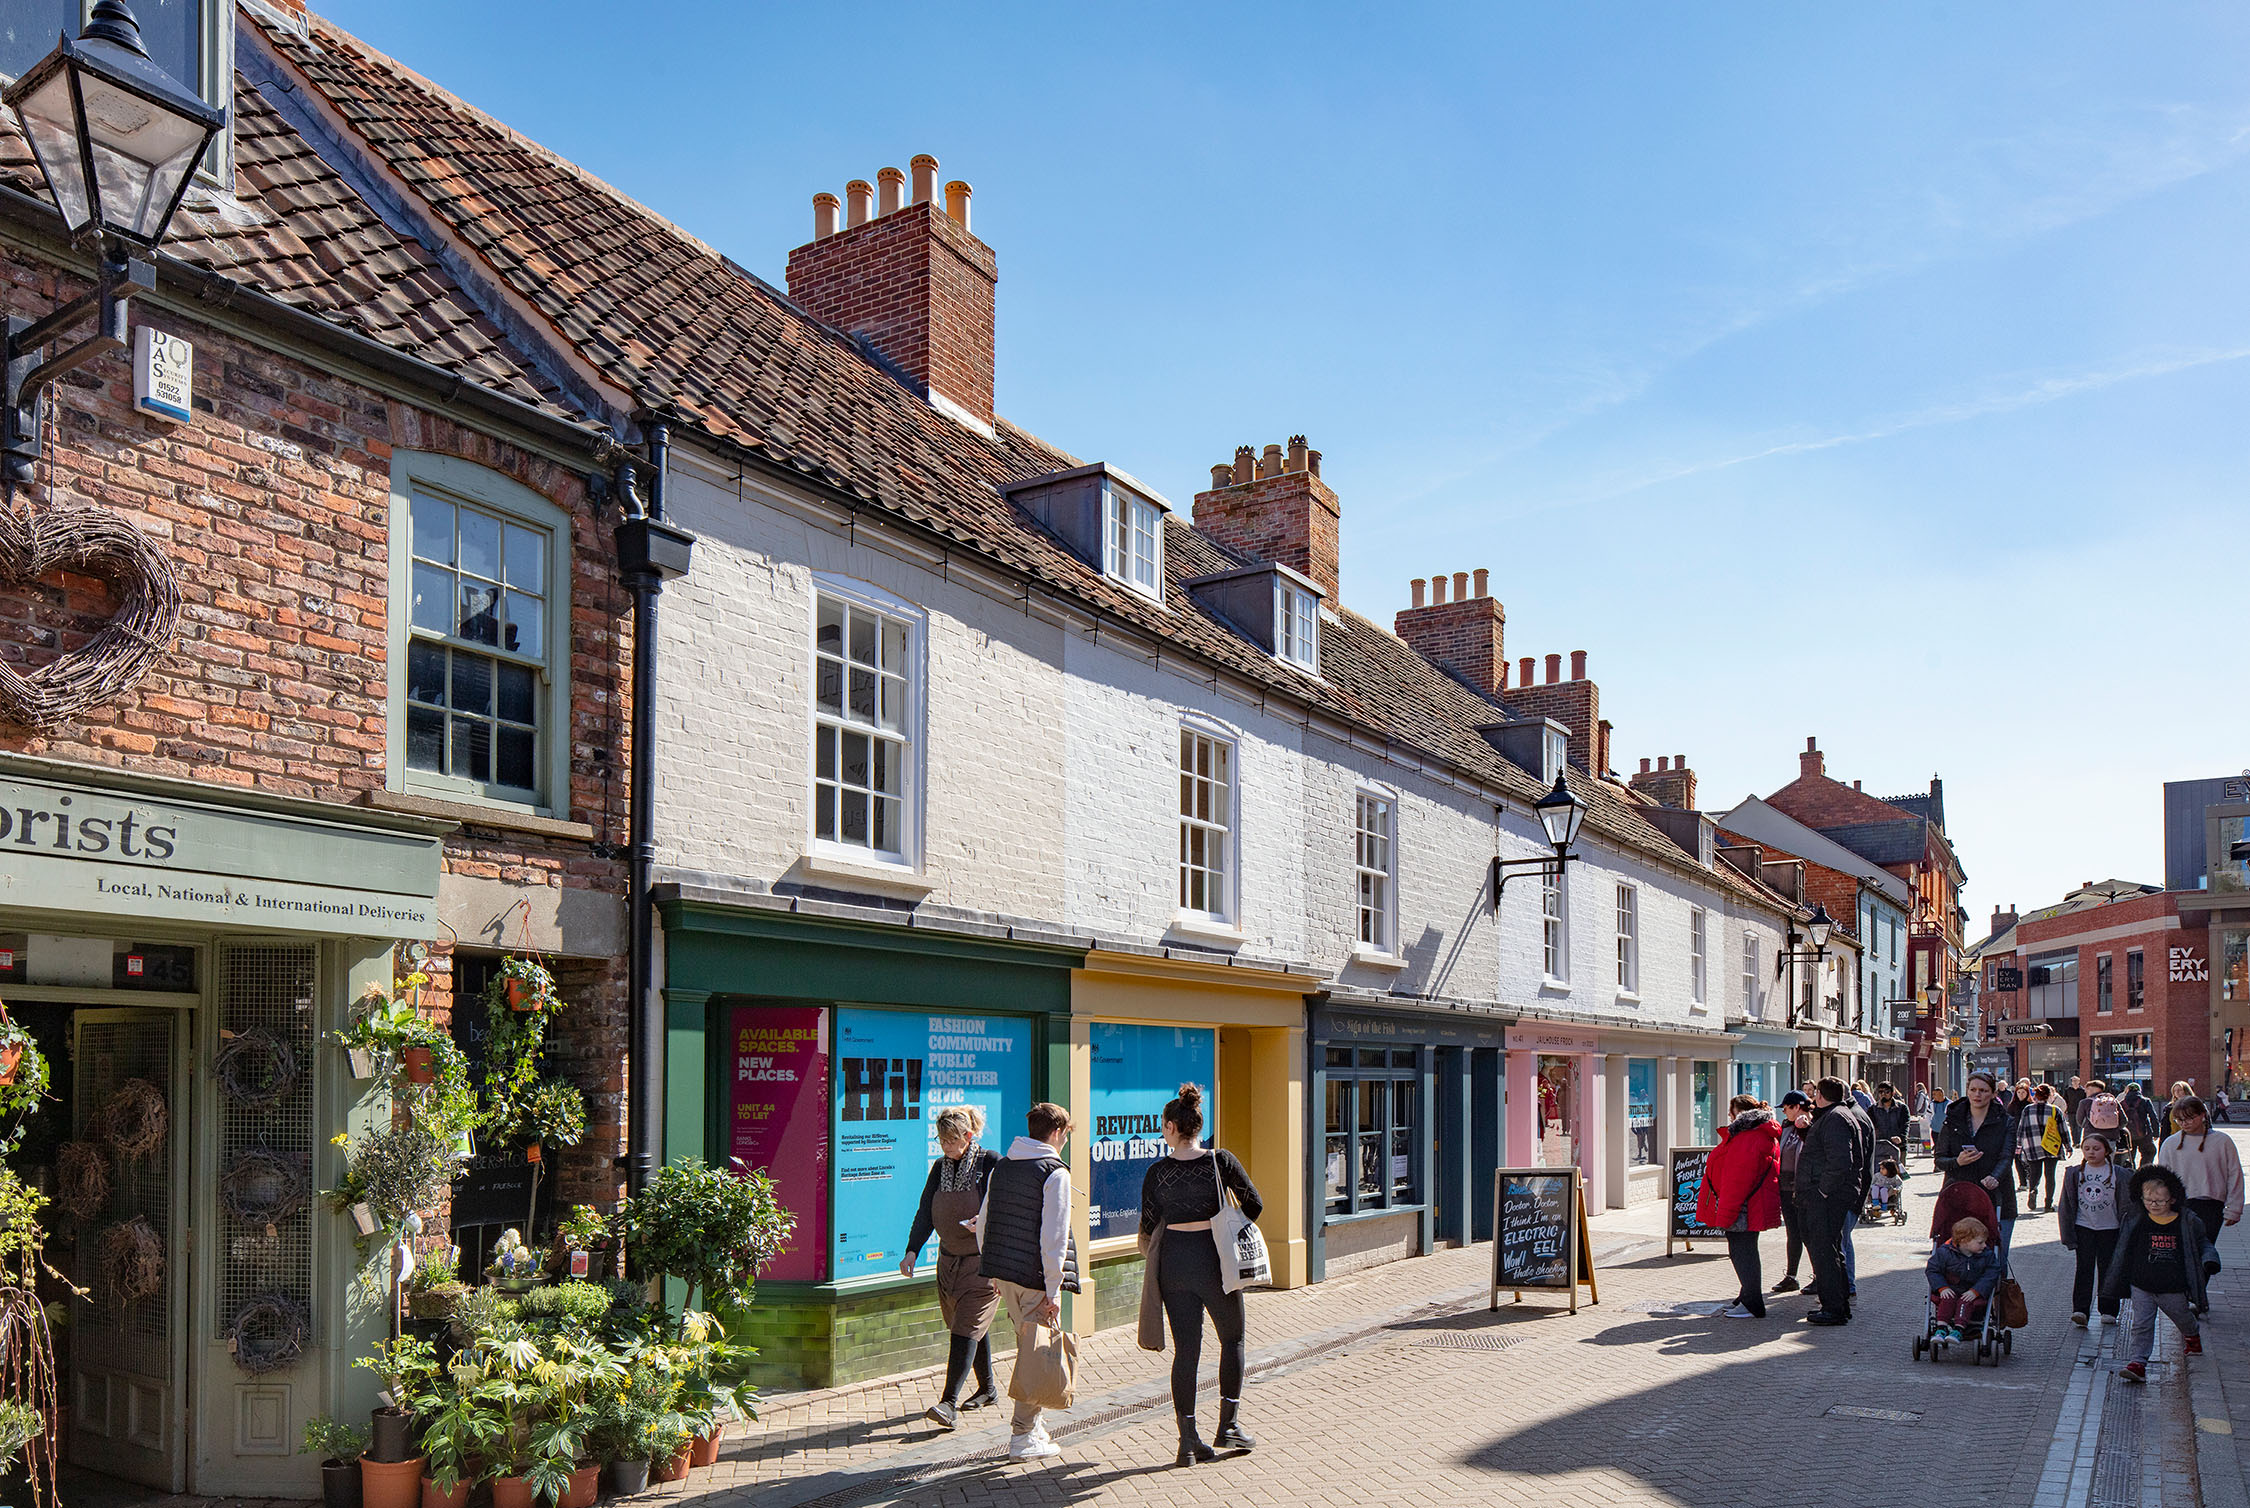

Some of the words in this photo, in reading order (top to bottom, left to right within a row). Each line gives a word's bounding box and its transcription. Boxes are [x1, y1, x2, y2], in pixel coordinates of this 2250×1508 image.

[158, 381, 180, 395] 01522
[156, 389, 181, 404] 531058
[97, 878, 152, 898] Local,
[157, 885, 229, 904] National
[235, 892, 249, 906] &
[255, 895, 354, 916] International
[358, 904, 425, 922] Deliveries
[2170, 947, 2193, 958] EV
[2170, 959, 2206, 970] ERY
[2170, 970, 2209, 982] MAN
[928, 1017, 985, 1034] FASHION
[2006, 1024, 2038, 1035] EVERYMAN
[739, 1029, 818, 1041] AVAILABLE
[739, 1041, 799, 1053] SPACES.
[928, 1035, 1013, 1052] COMMUNITY
[739, 1057, 773, 1069] NEW
[928, 1053, 976, 1068] PUBLIC
[738, 1070, 799, 1082] PLACES.
[928, 1070, 998, 1086] TOGETHER
[841, 1057, 922, 1122] Hi!
[928, 1088, 964, 1103] CIVIC
[737, 1104, 761, 1112] UNIT
[763, 1104, 775, 1112] 44
[737, 1112, 750, 1120] TO
[752, 1112, 769, 1120] LET
[1096, 1114, 1163, 1136] REVITAL
[1092, 1141, 1125, 1162] OUR
[1675, 1153, 1700, 1172] Award
[1676, 1169, 1696, 1183] FISH
[1504, 1200, 1532, 1214] Doctor,
[1534, 1196, 1560, 1209] Doctor,
[1674, 1202, 1697, 1213] RESTA
[2080, 1198, 2111, 1213] MOUSE
[1102, 1210, 1119, 1219] Historic
[1120, 1207, 1137, 1218] England
[1503, 1217, 1511, 1231] I
[1511, 1215, 1532, 1228] think
[1532, 1210, 1549, 1225] I'm
[1504, 1225, 1559, 1245] ELECTRIC
[1535, 1262, 1568, 1278] shocking
